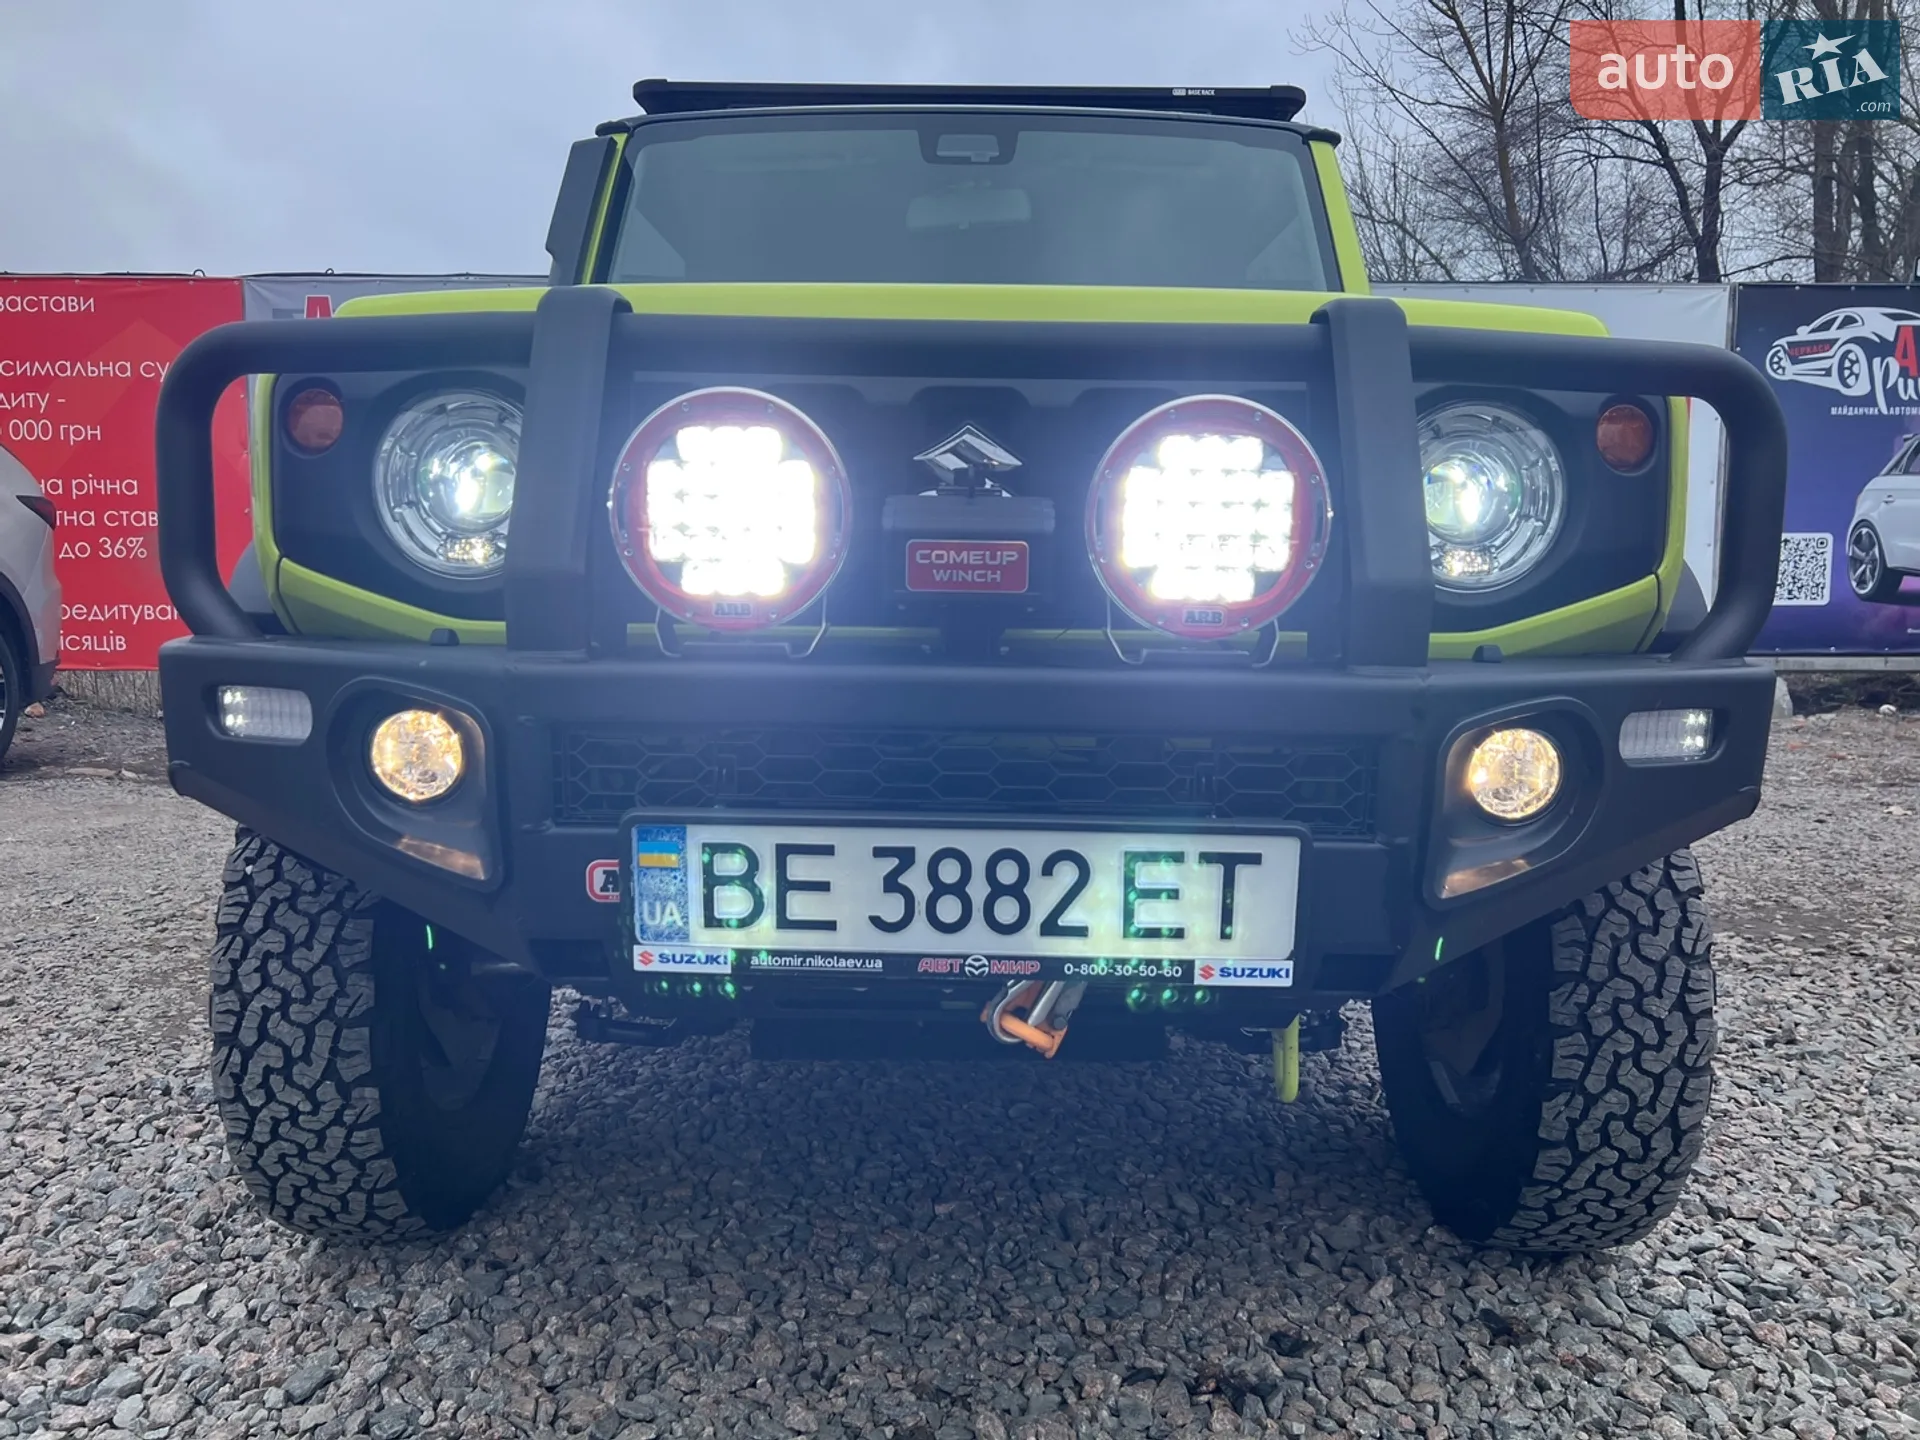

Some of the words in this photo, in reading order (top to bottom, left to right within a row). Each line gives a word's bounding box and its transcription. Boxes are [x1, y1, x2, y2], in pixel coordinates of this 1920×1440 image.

[1889, 406, 1920, 416] АВТОМ
[9, 418, 53, 441] 000
[59, 424, 102, 445] грн
[71, 473, 138, 500] річна
[58, 541, 91, 560] до
[98, 536, 148, 560] 36%
[915, 549, 1019, 565] COMEUP
[932, 569, 1001, 582] WINCH
[701, 842, 839, 932] BE
[867, 846, 1092, 938] 3882
[1121, 850, 1263, 943] ET
[642, 900, 684, 927] UA
[658, 952, 729, 966] SUZUKI
[750, 955, 883, 970] automir.nikolaev.ua
[1063, 963, 1183, 978] 0-800-30-50-60
[1218, 966, 1291, 980] SUZUKI
